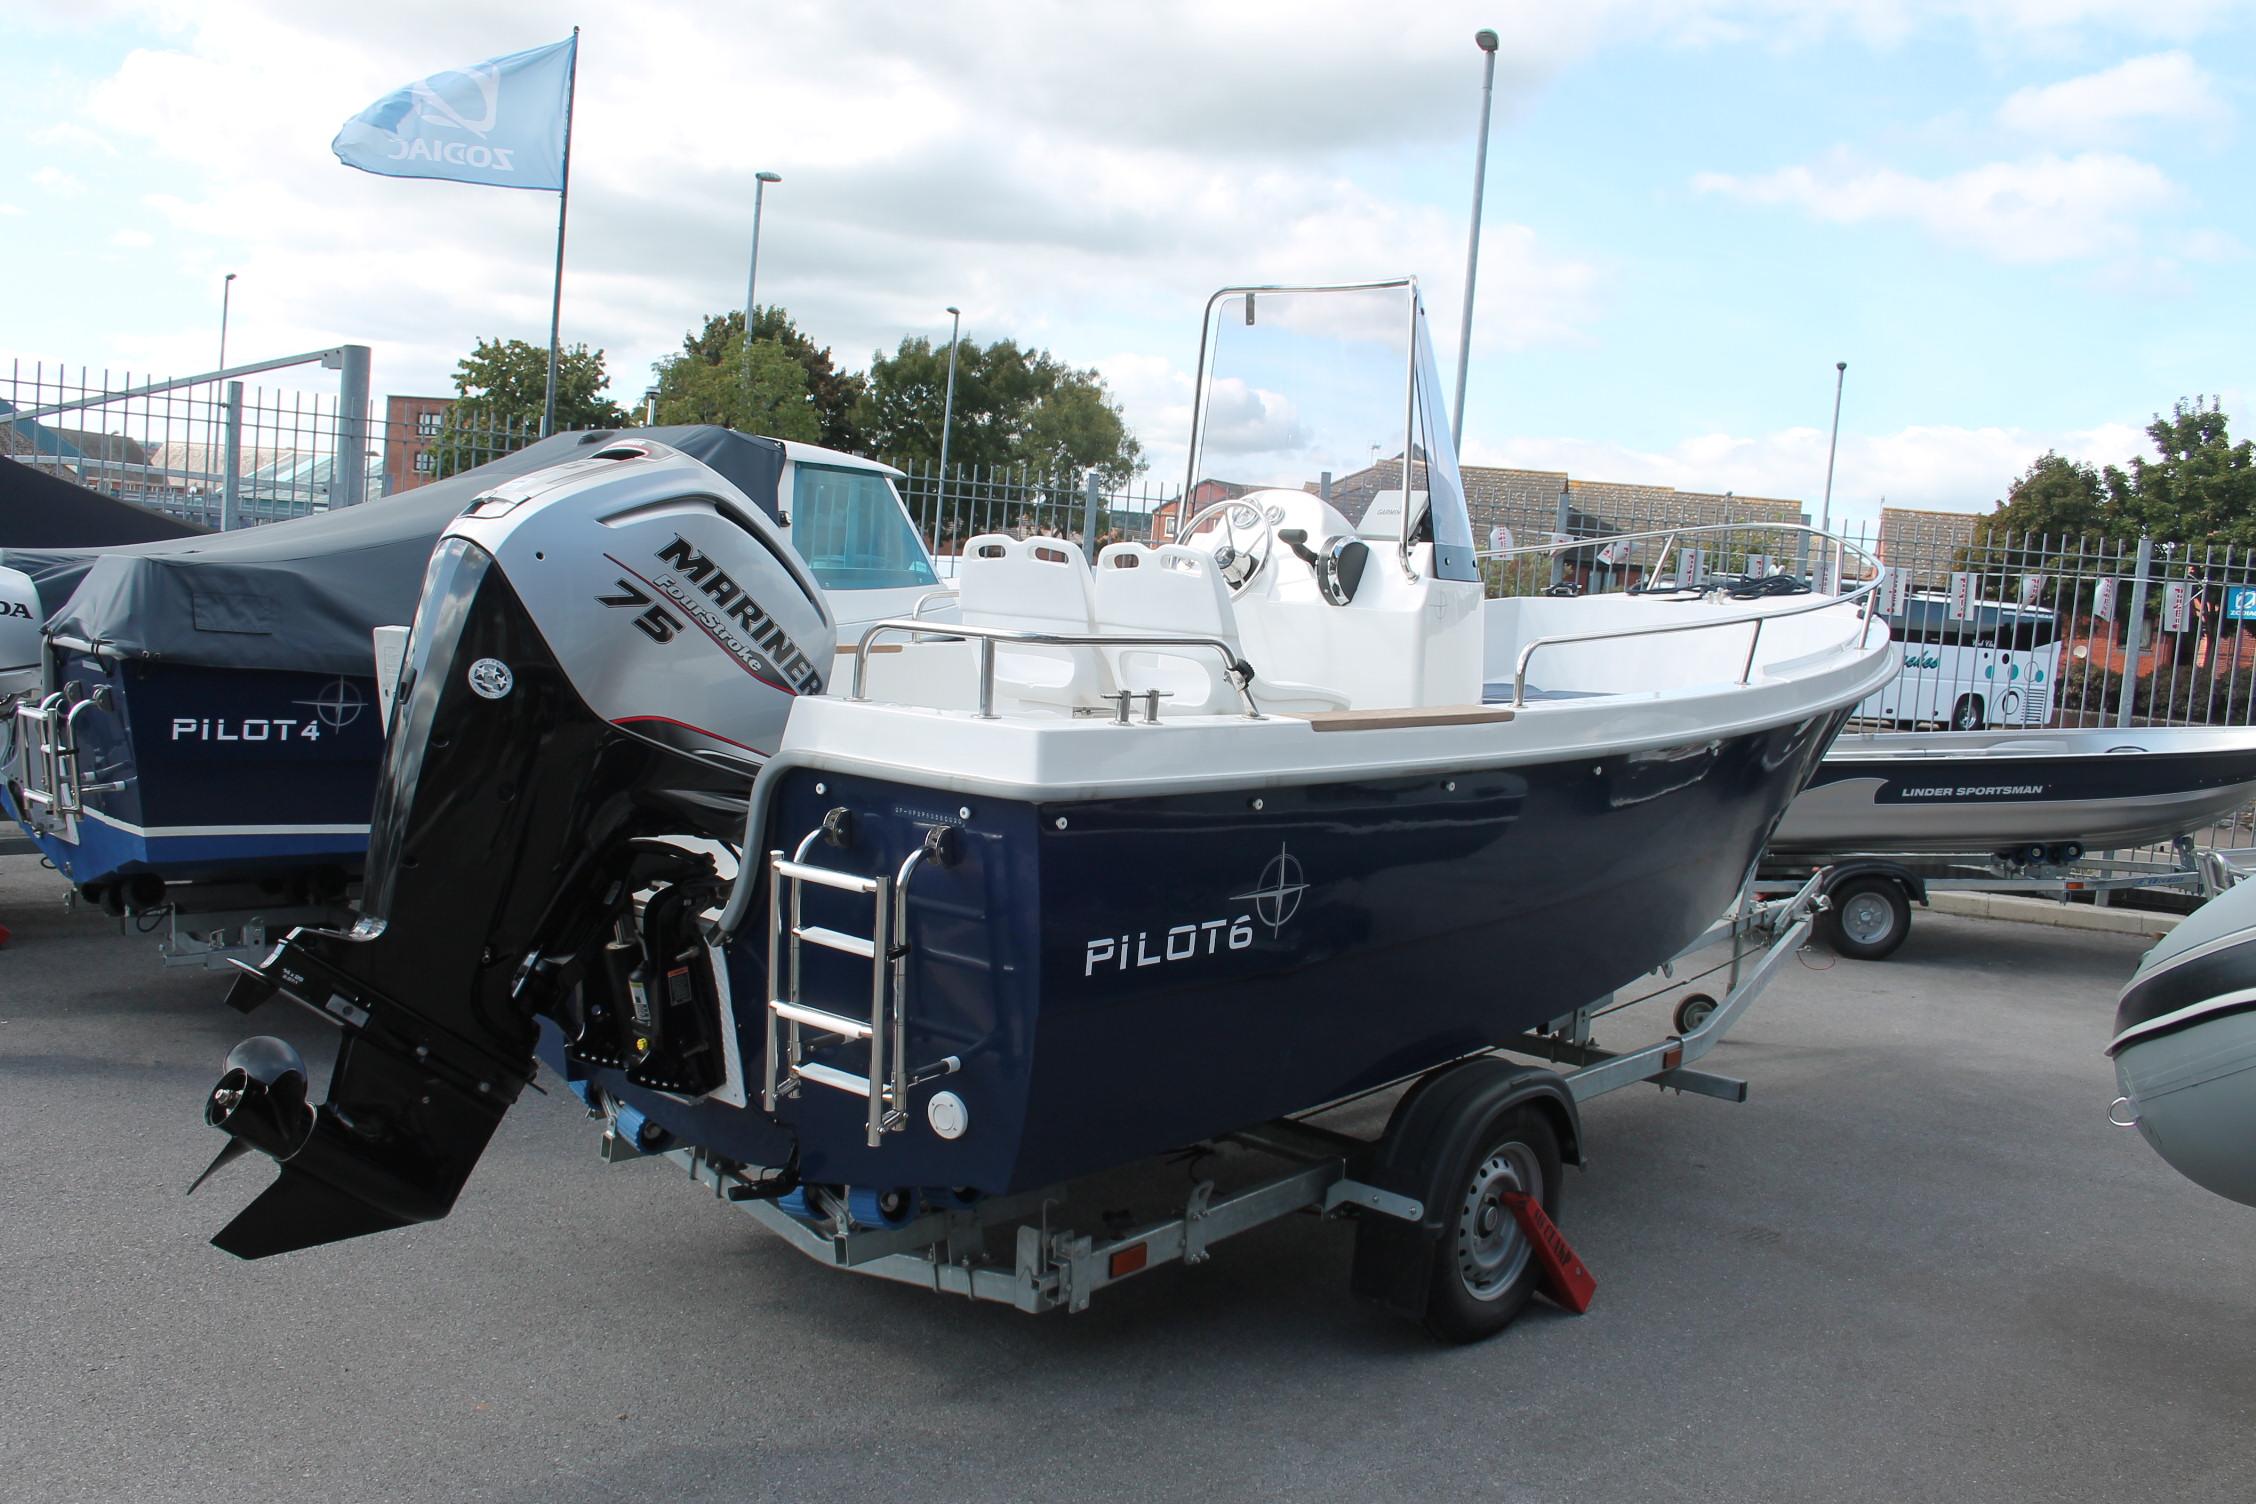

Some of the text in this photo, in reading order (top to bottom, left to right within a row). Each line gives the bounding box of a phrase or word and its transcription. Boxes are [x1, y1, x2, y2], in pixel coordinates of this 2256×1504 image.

[594, 577, 687, 645] 75
[653, 573, 763, 672] FourStroke
[654, 532, 823, 696] MARINER
[2230, 609, 2256, 617] ZODIA
[171, 718, 320, 742] PILOT4
[1901, 784, 2043, 798] LINDER SPORTSMAN
[1084, 914, 1254, 977] PILOT6
